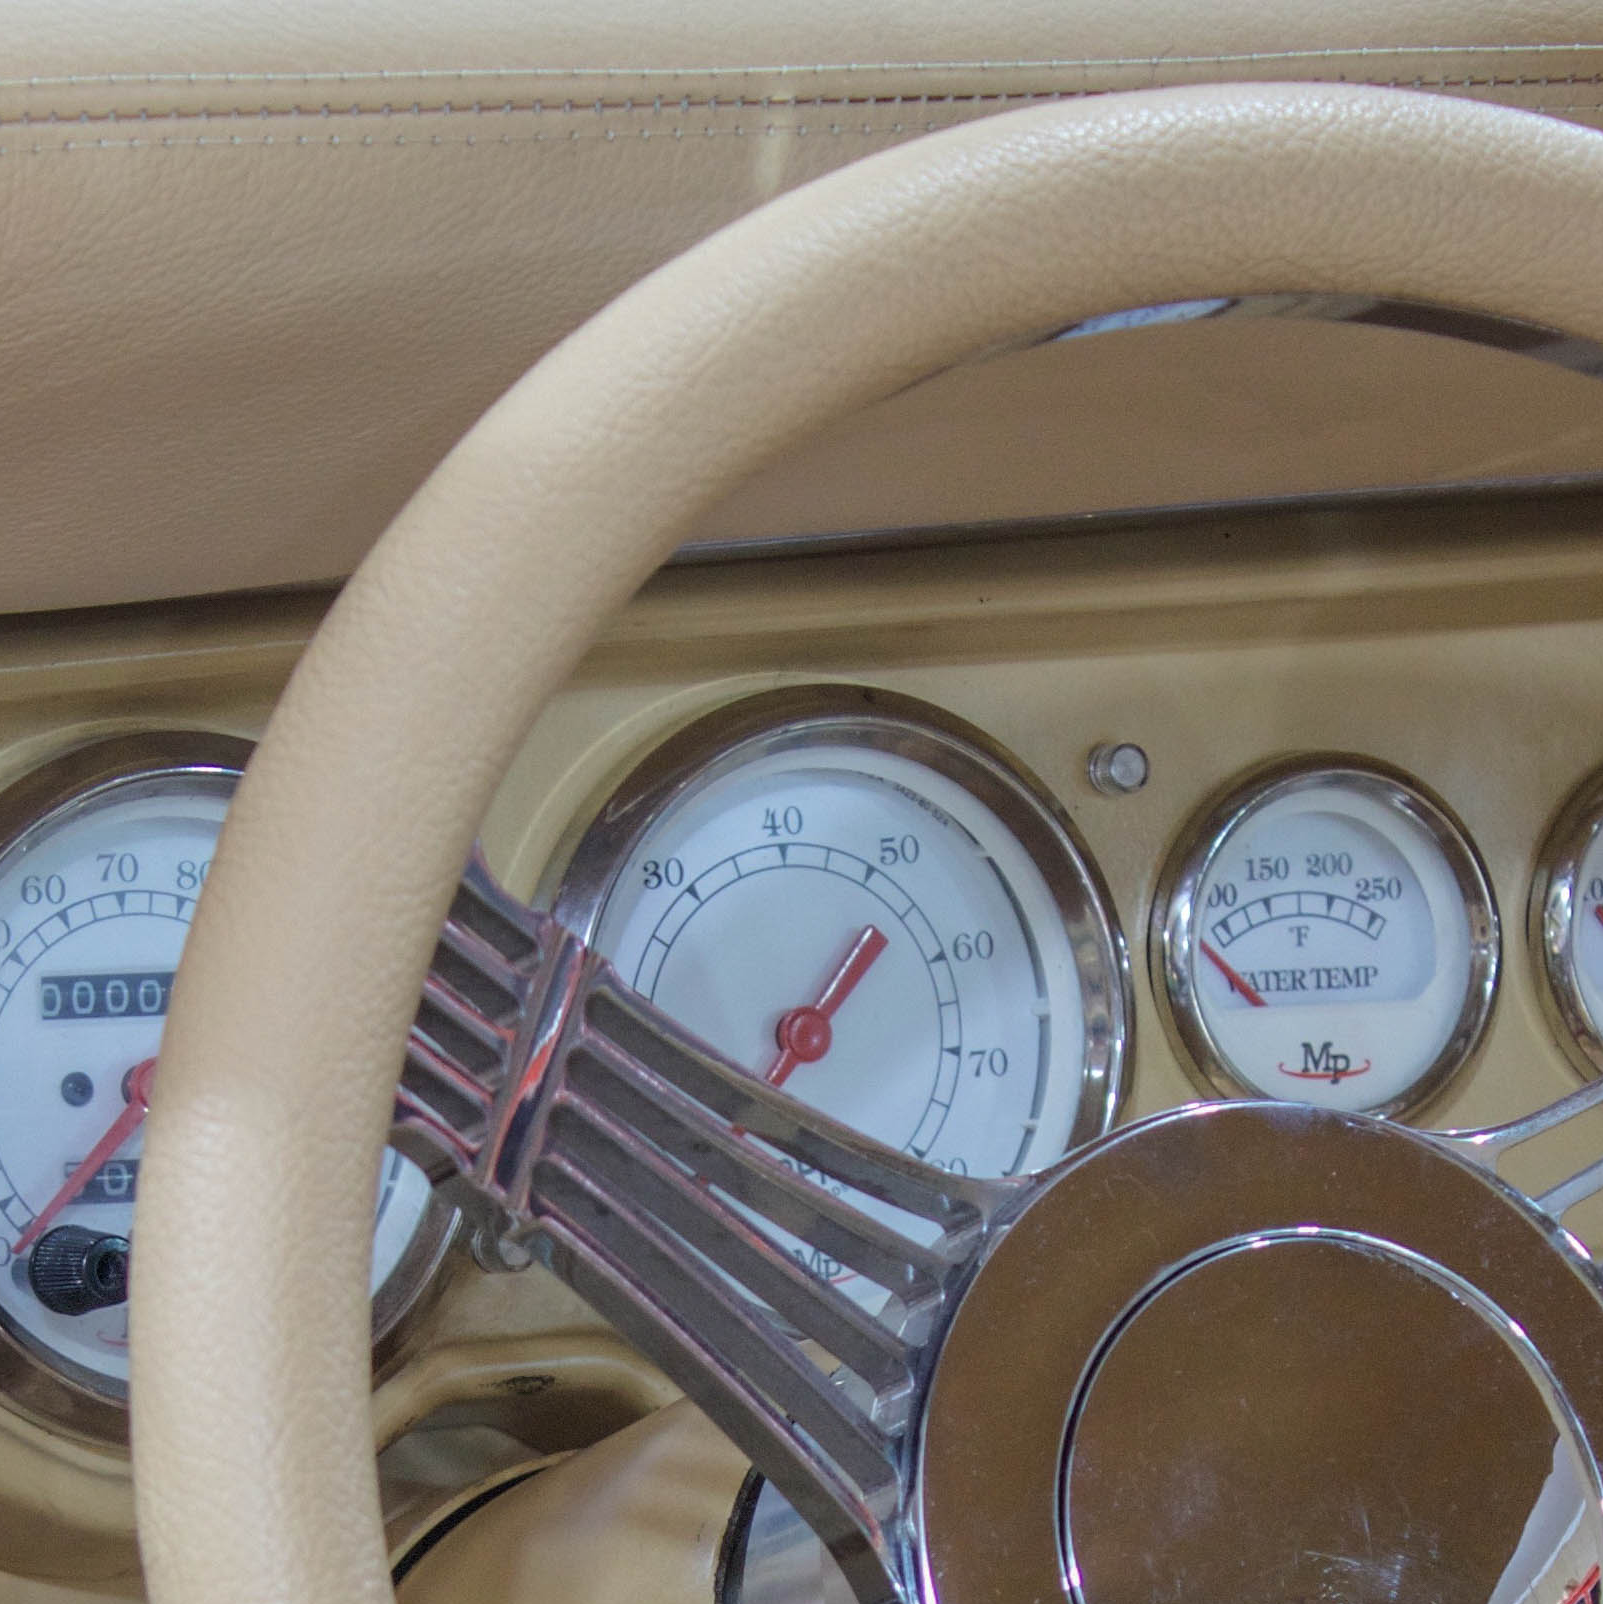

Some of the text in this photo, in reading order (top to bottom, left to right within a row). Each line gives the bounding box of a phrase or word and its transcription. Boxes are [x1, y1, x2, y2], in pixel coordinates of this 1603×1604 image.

[762, 805, 803, 836] 40
[879, 834, 920, 865] 50
[1305, 851, 1354, 878] 200
[96, 853, 139, 883] 70
[642, 857, 685, 889] 30
[1245, 855, 1290, 882] 150
[21, 873, 66, 904] 60
[1355, 876, 1403, 902] 250
[952, 931, 995, 962] 60
[1310, 965, 1379, 992] TEMP
[968, 1047, 1010, 1079] 70
